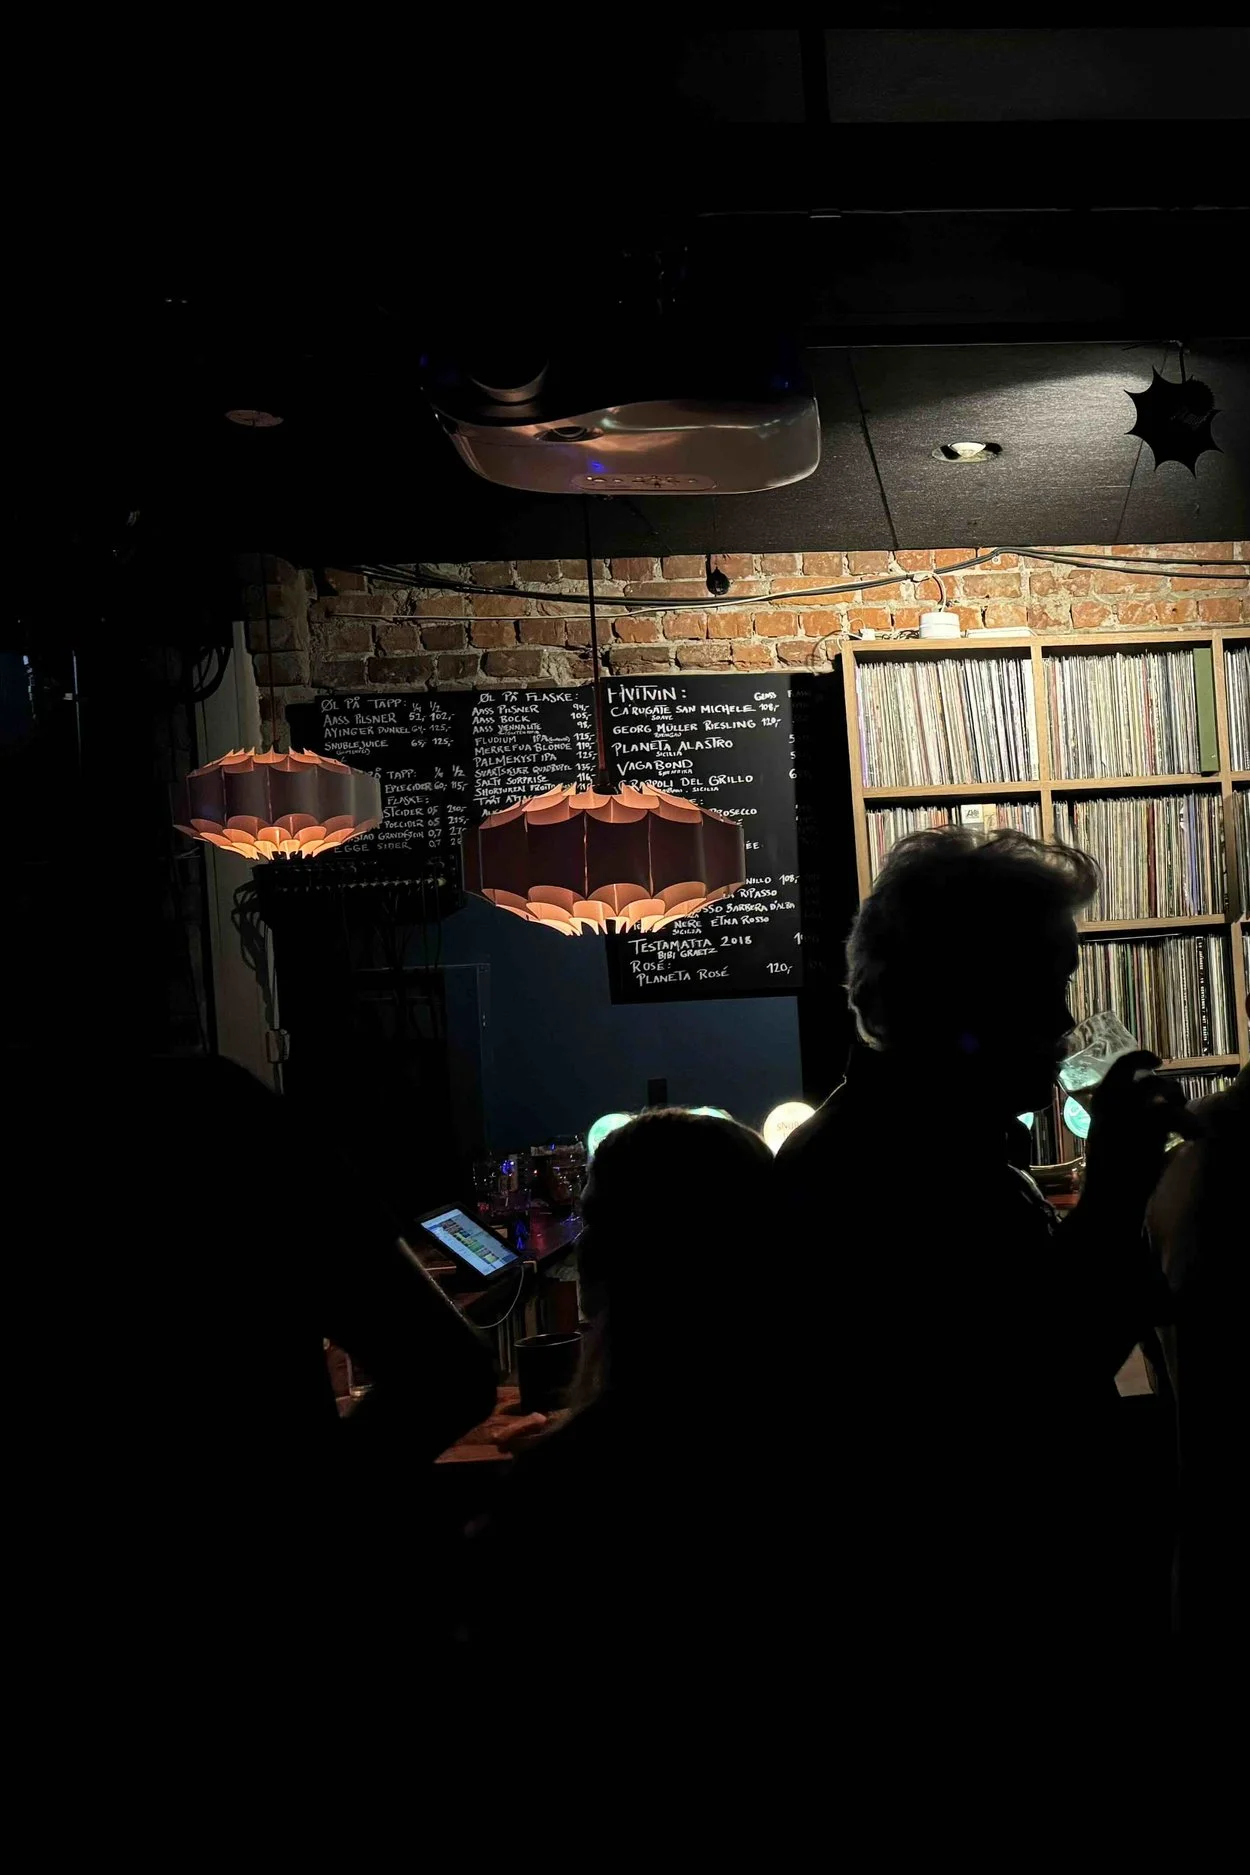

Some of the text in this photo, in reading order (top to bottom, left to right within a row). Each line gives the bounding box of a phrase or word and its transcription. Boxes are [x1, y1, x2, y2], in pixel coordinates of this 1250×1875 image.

[321, 699, 340, 713] ØL
[344, 696, 361, 709] PÅ
[479, 692, 496, 705] ØL
[501, 691, 519, 702] PÅ
[675, 705, 696, 714] SAN
[700, 704, 757, 714] MICHELE
[499, 715, 531, 723] BOCK
[324, 727, 374, 739] AYINGER
[612, 724, 652, 735] GEORG
[702, 719, 757, 732] RIESLING
[611, 736, 734, 756] PLANETA ALASTRO
[541, 752, 557, 761] IPA
[616, 759, 694, 777] VAGABOND
[680, 777, 704, 787] DEL
[708, 774, 754, 786] GRILLO
[627, 938, 713, 955] TESTAMATTA
[656, 951, 676, 960] BIBI
[635, 969, 692, 988] PLANETA
